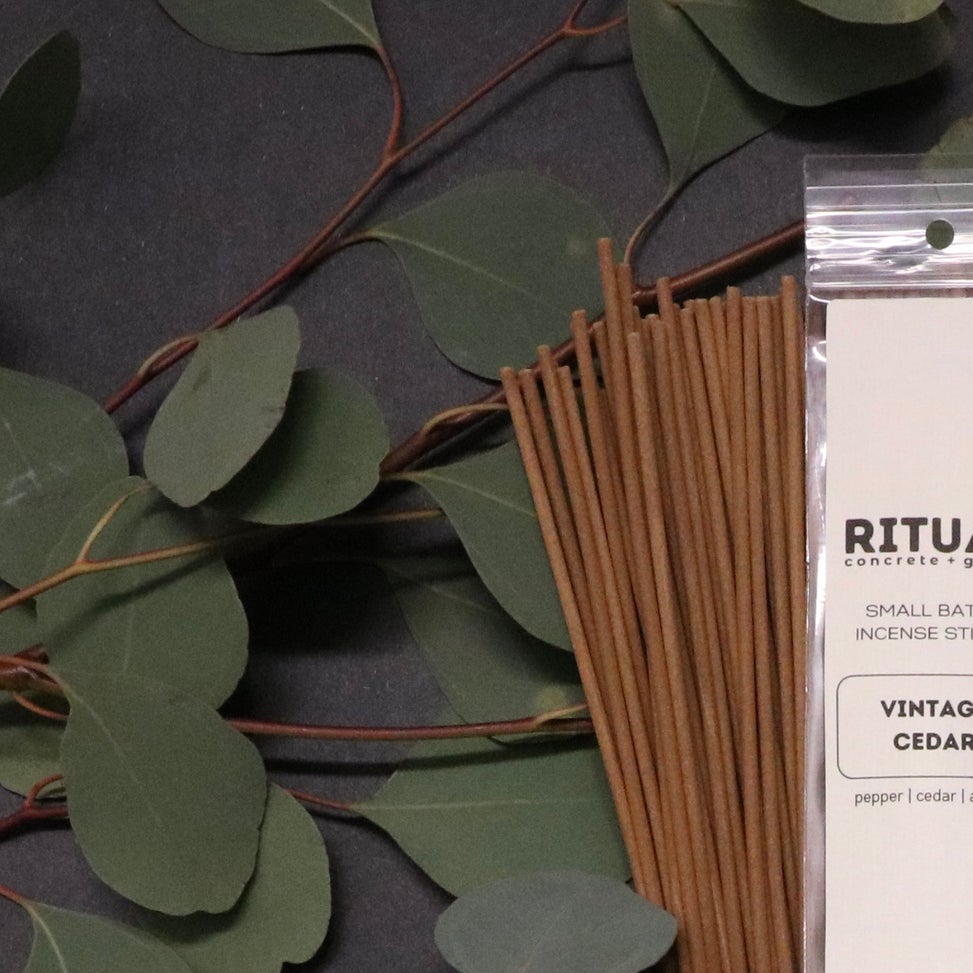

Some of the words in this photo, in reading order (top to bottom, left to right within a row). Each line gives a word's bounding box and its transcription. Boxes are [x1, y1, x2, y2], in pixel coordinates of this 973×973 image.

[844, 556, 939, 567] concrete
[865, 604, 932, 618] SMALL
[856, 626, 938, 641] INCENSE
[854, 792, 903, 807] pepper
[916, 788, 957, 803] cedar
